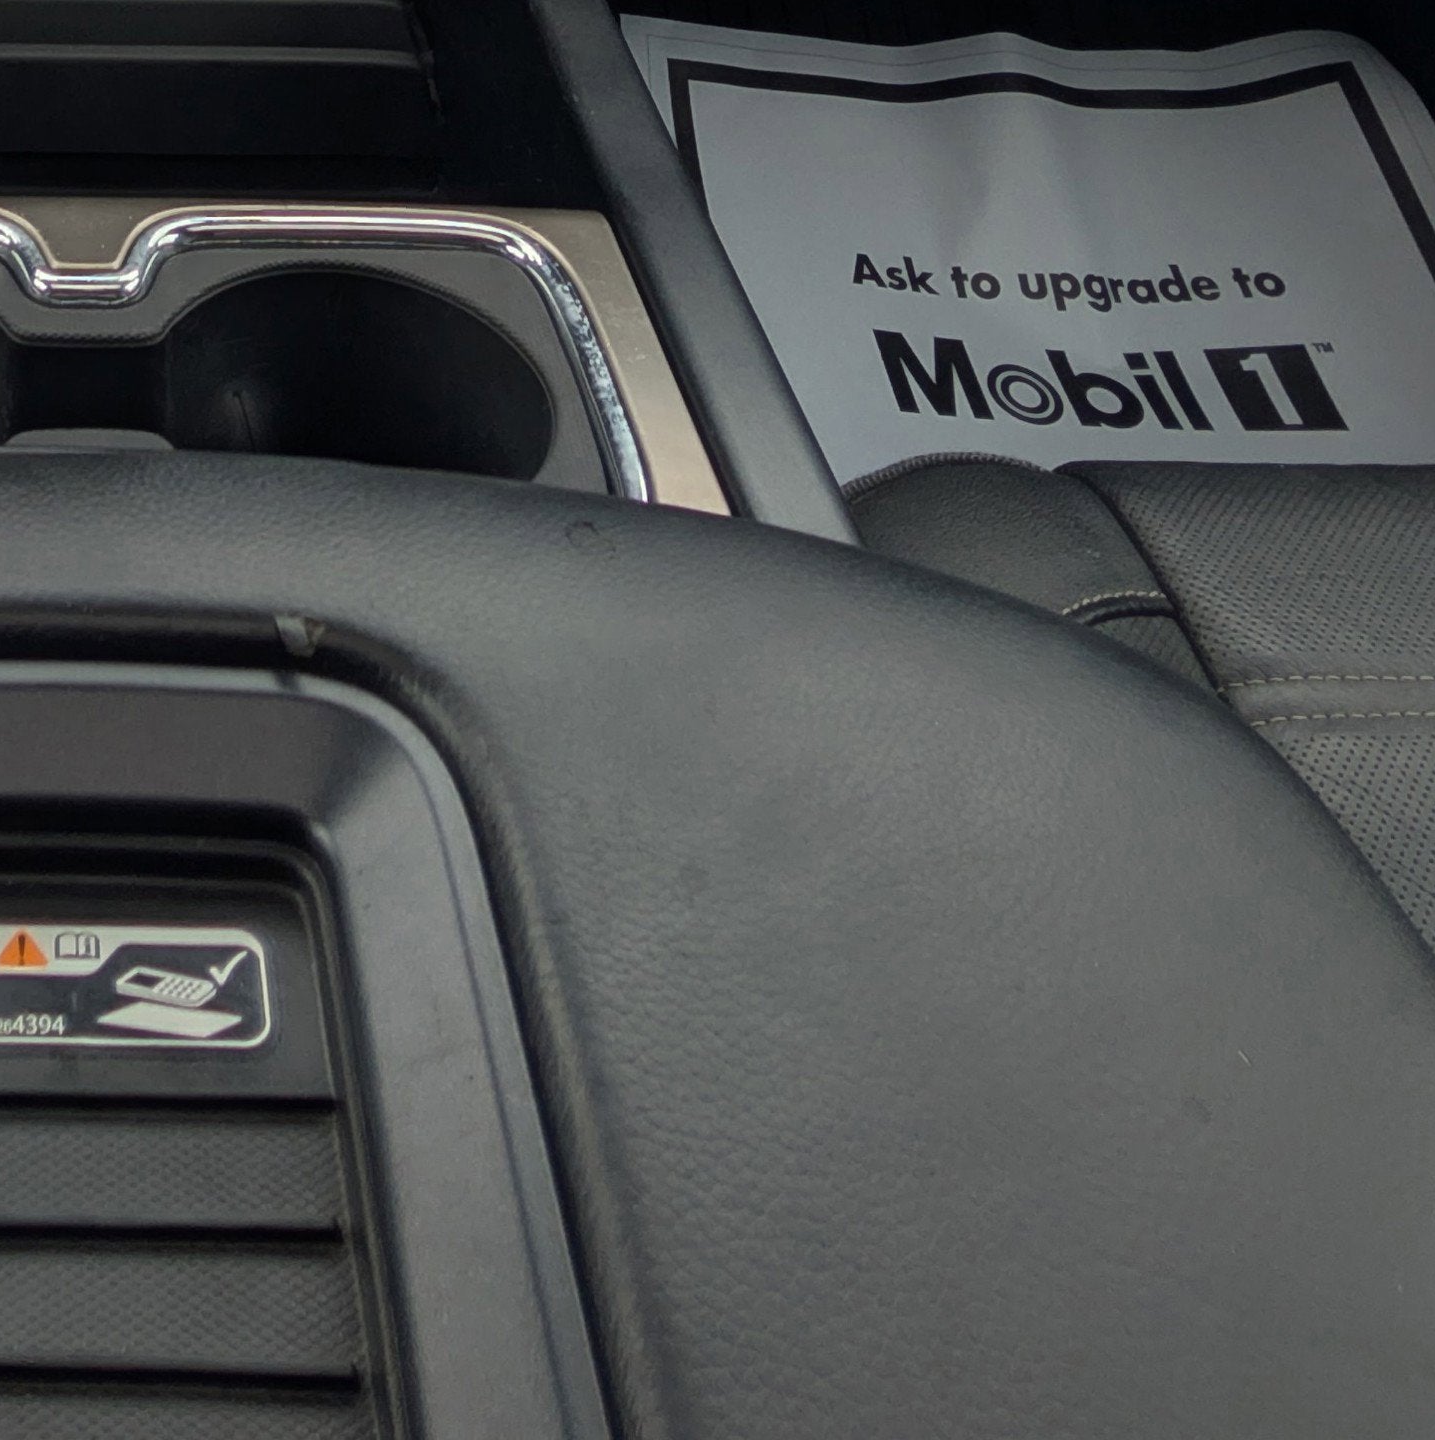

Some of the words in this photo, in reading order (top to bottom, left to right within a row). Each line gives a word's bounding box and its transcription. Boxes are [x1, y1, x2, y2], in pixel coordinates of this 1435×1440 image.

[852, 253, 938, 297] Ask
[950, 264, 1001, 301] to
[1018, 265, 1221, 312] upgrade
[1232, 264, 1286, 301] to
[872, 327, 1215, 432] Mobil
